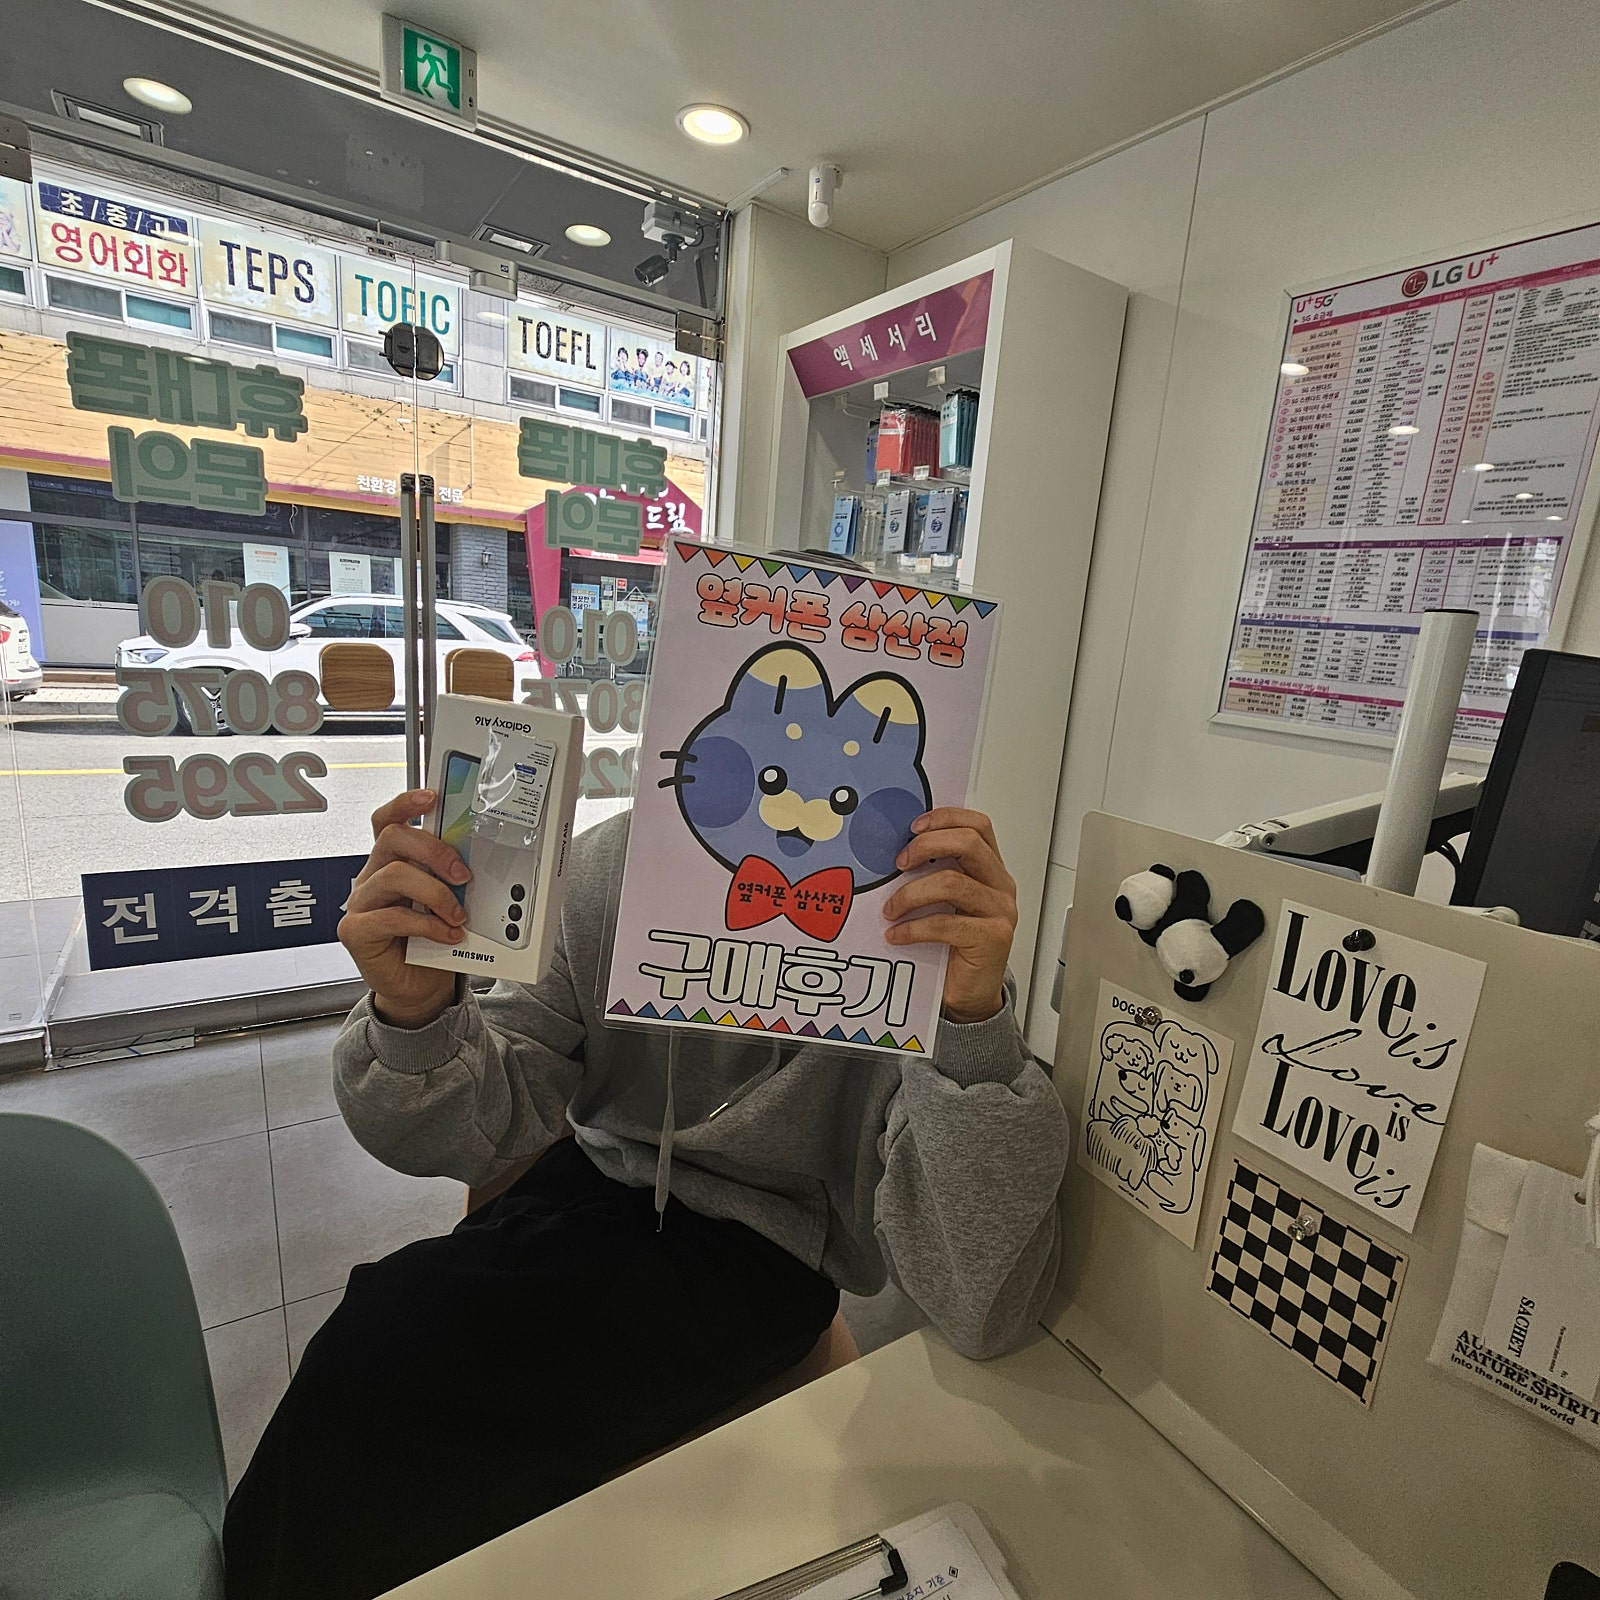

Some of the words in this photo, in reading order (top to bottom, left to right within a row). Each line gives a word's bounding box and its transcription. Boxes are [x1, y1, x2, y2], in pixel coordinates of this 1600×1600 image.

[51, 222, 188, 288] 영어회화
[219, 239, 315, 304] TEPS
[1431, 263, 1463, 289] LG
[354, 274, 451, 336] TOEIC
[518, 316, 597, 371] TOEFL
[357, 474, 397, 494] 친환경
[438, 486, 464, 503] 전문
[696, 572, 833, 643] 옆커폰
[839, 600, 970, 669] 삼산점
[474, 715, 492, 727] A16
[491, 717, 532, 734] Galaxy
[738, 882, 787, 907] 옆커폰
[793, 887, 845, 915] 삼산점
[451, 949, 495, 963] SAMSUNG
[638, 928, 916, 1029] 구매후기
[1507, 1296, 1536, 1358] SACHET
[1451, 1353, 1473, 1370] Into
[1475, 1366, 1493, 1381] the
[1495, 1378, 1538, 1406] natural
[1540, 1401, 1576, 1426] world
[1455, 1339, 1529, 1388] NATURE
[1530, 1380, 1600, 1426] SPIRIT
